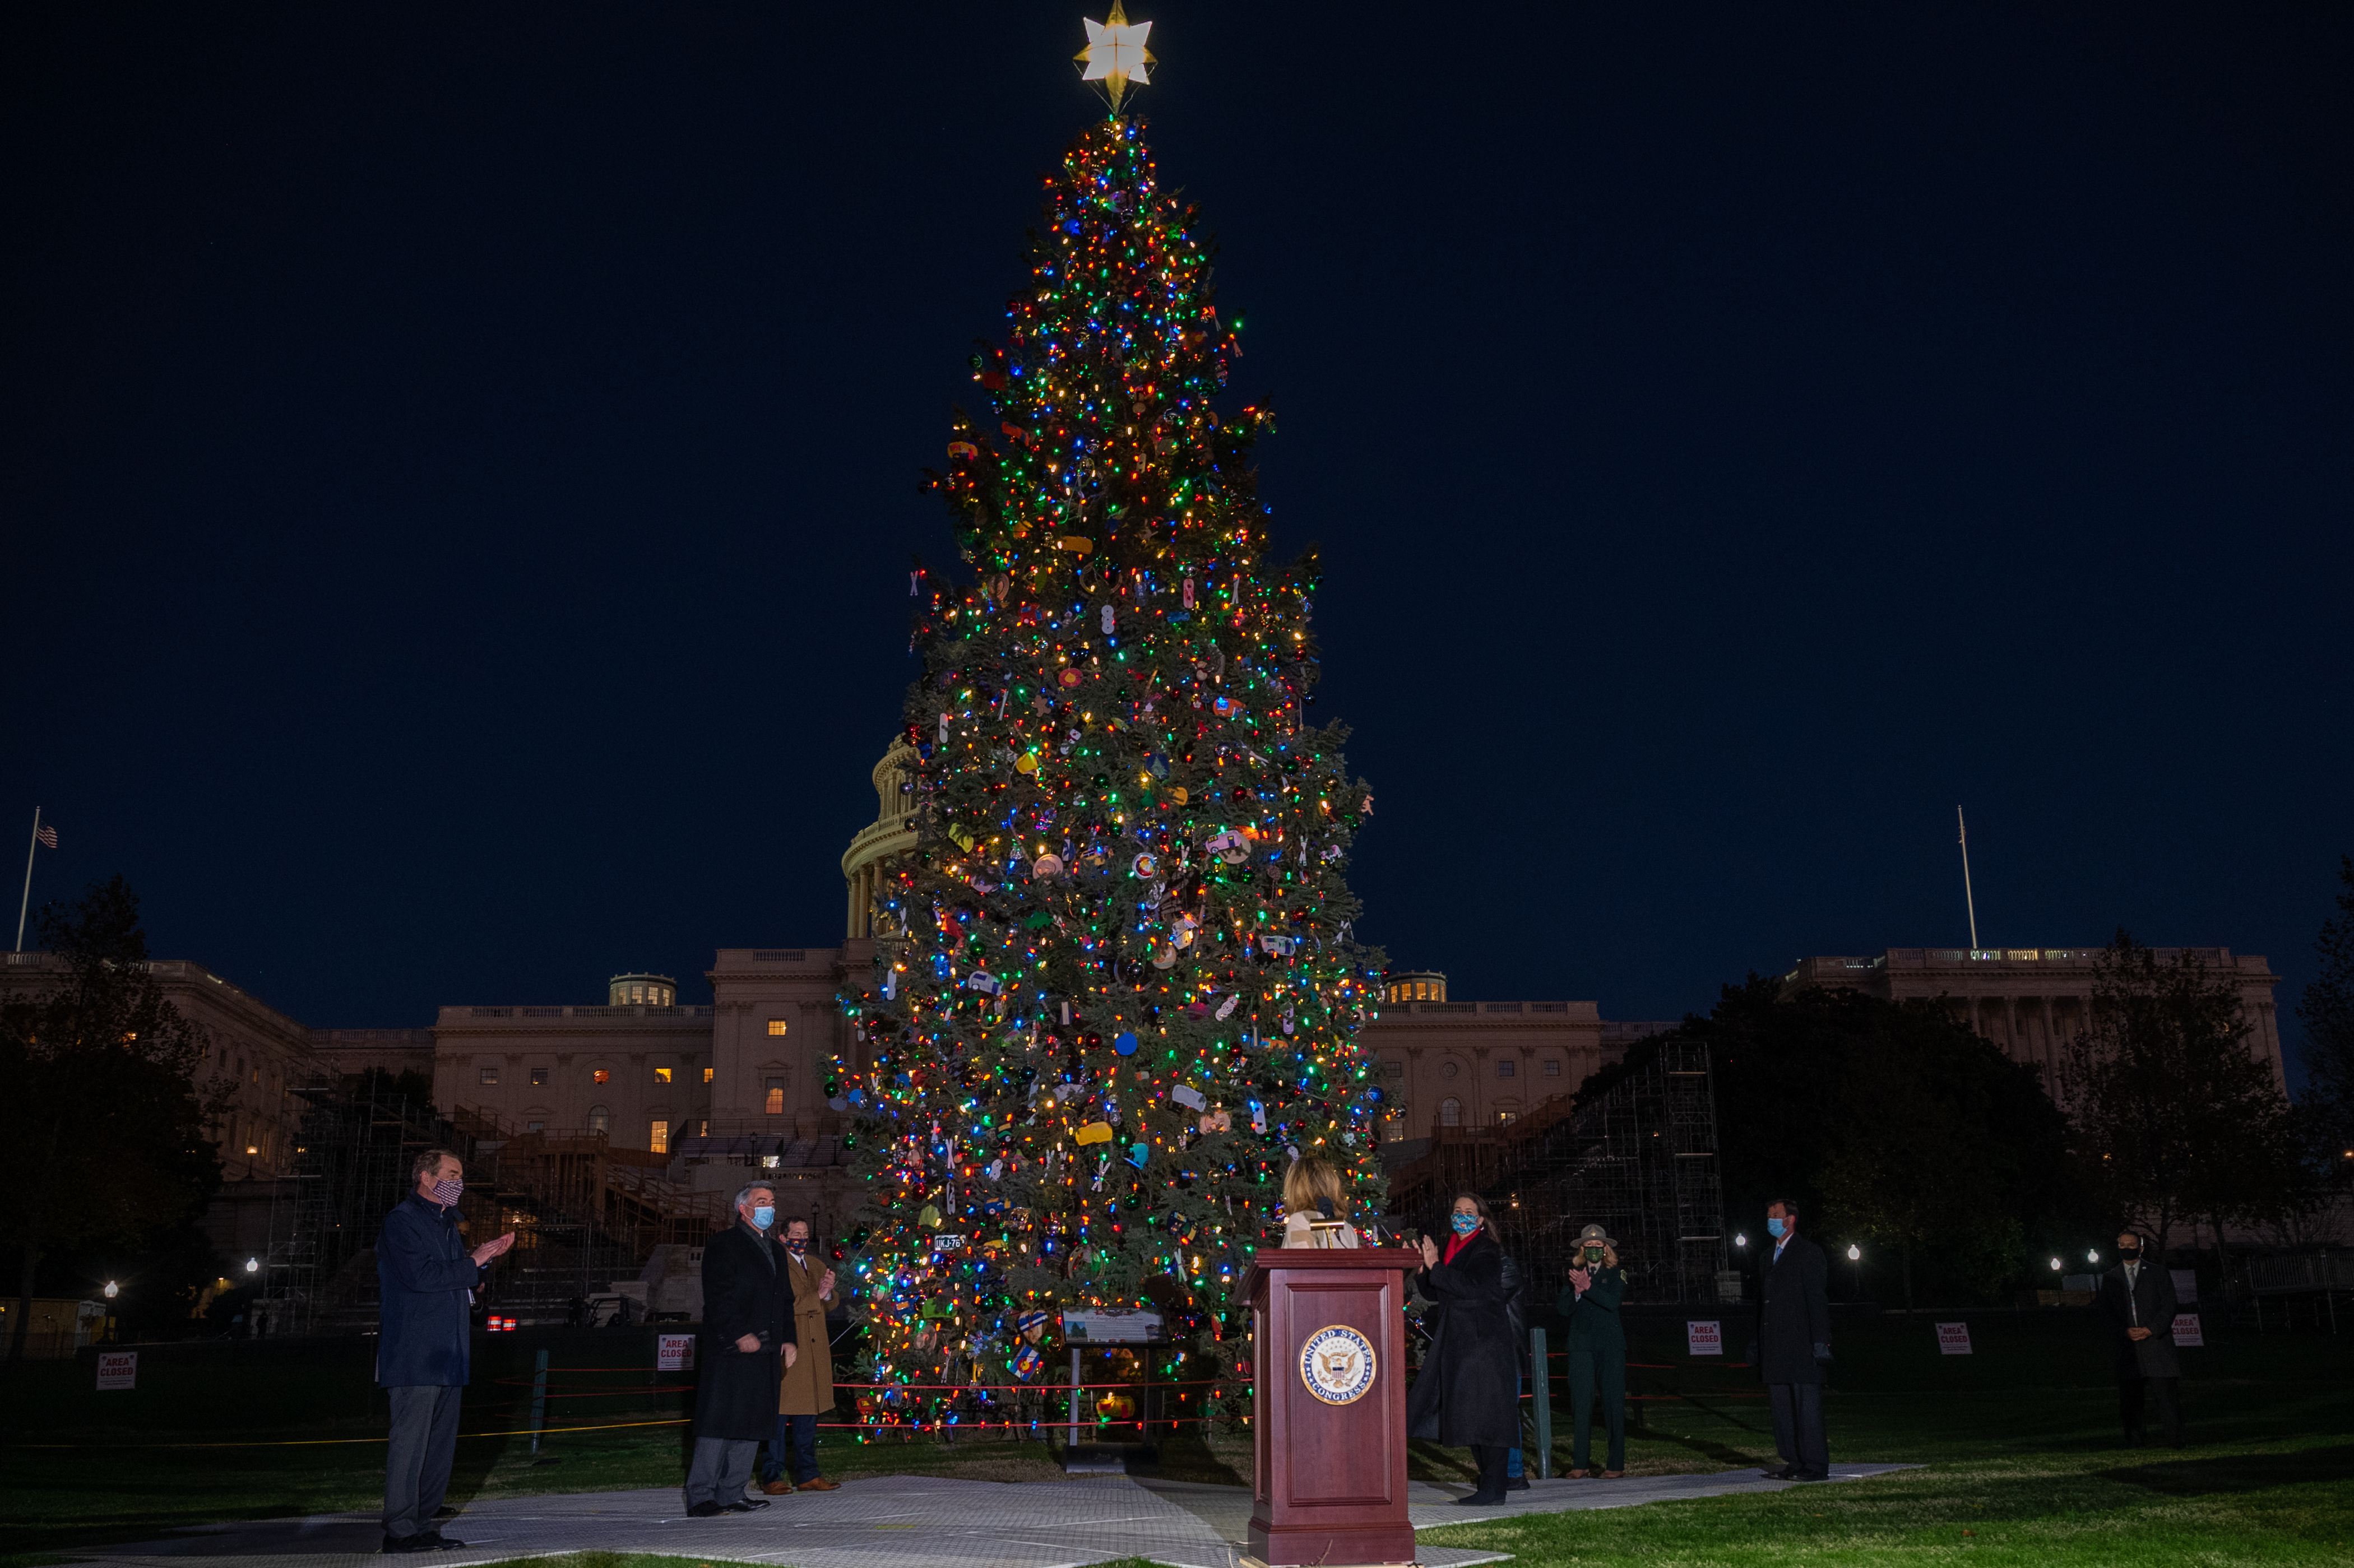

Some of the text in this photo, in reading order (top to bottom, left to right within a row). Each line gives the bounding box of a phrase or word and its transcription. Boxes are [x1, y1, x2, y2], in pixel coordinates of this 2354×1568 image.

[1305, 1330, 1371, 1364] UNITED STATES
[105, 1358, 129, 1366] AREA
[100, 1367, 133, 1376] CLOSED
[1312, 1382, 1366, 1400] CONGRESS
